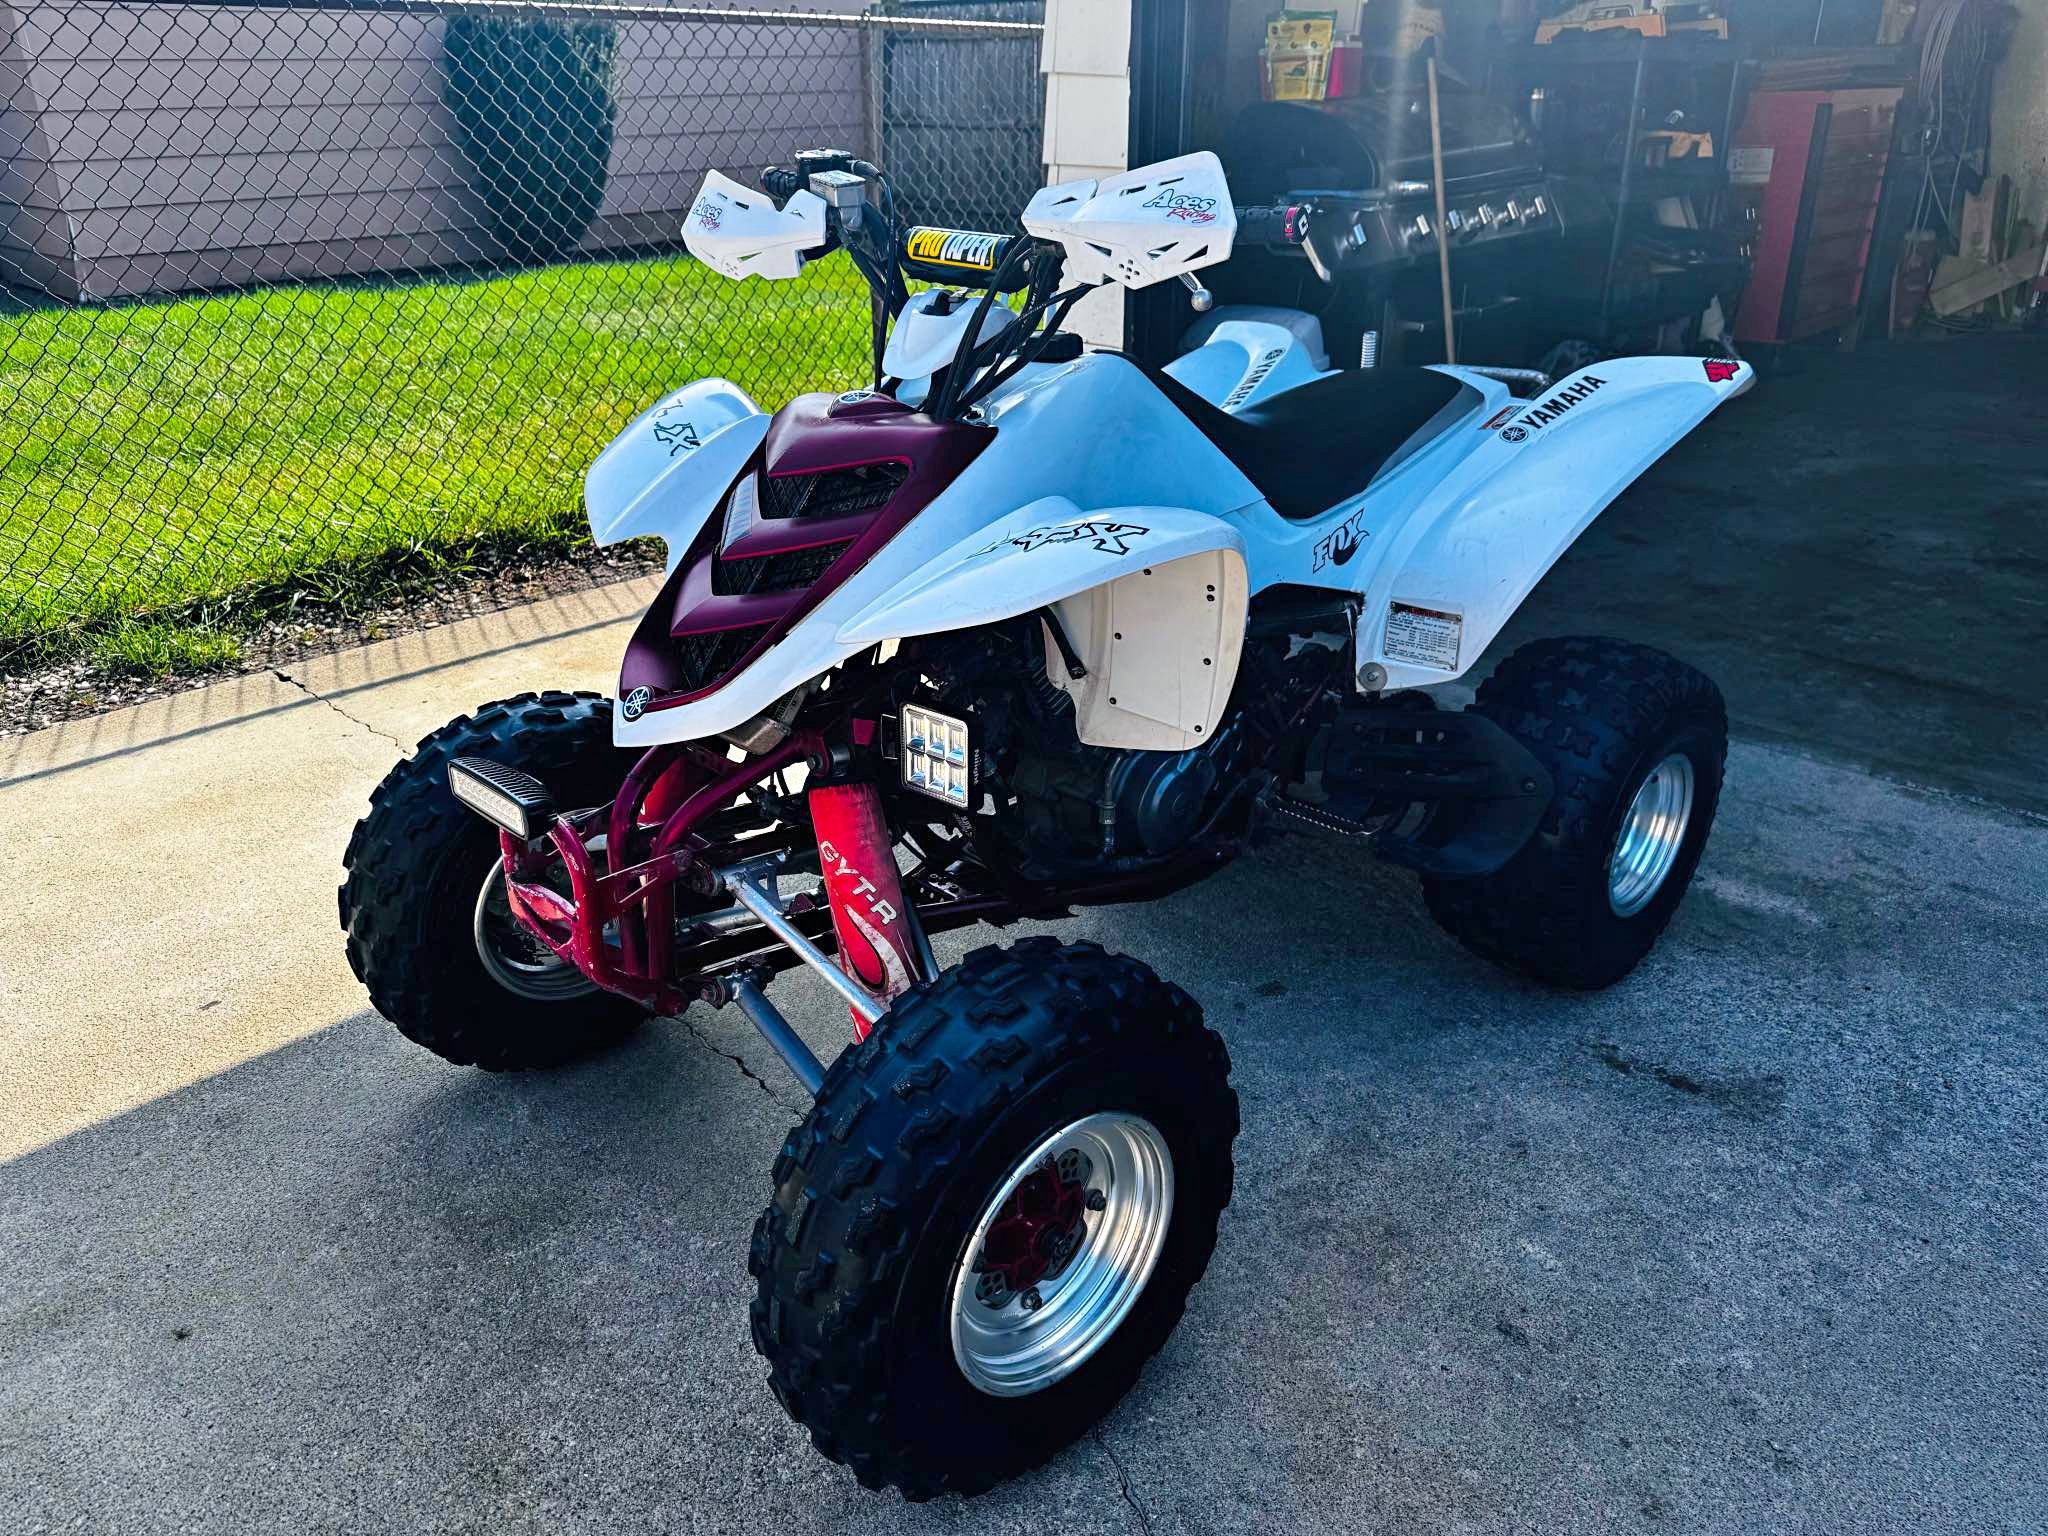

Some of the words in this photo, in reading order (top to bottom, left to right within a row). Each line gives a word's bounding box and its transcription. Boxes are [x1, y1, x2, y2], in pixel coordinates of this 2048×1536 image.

[692, 196, 723, 221] Aces
[1142, 188, 1217, 213] Aces
[1166, 207, 1217, 224] Racing
[1221, 359, 1277, 409] YAMAHA
[1517, 375, 1608, 430] YAMAHA
[1312, 507, 1370, 575] FOX
[820, 840, 897, 925] GYT-R
